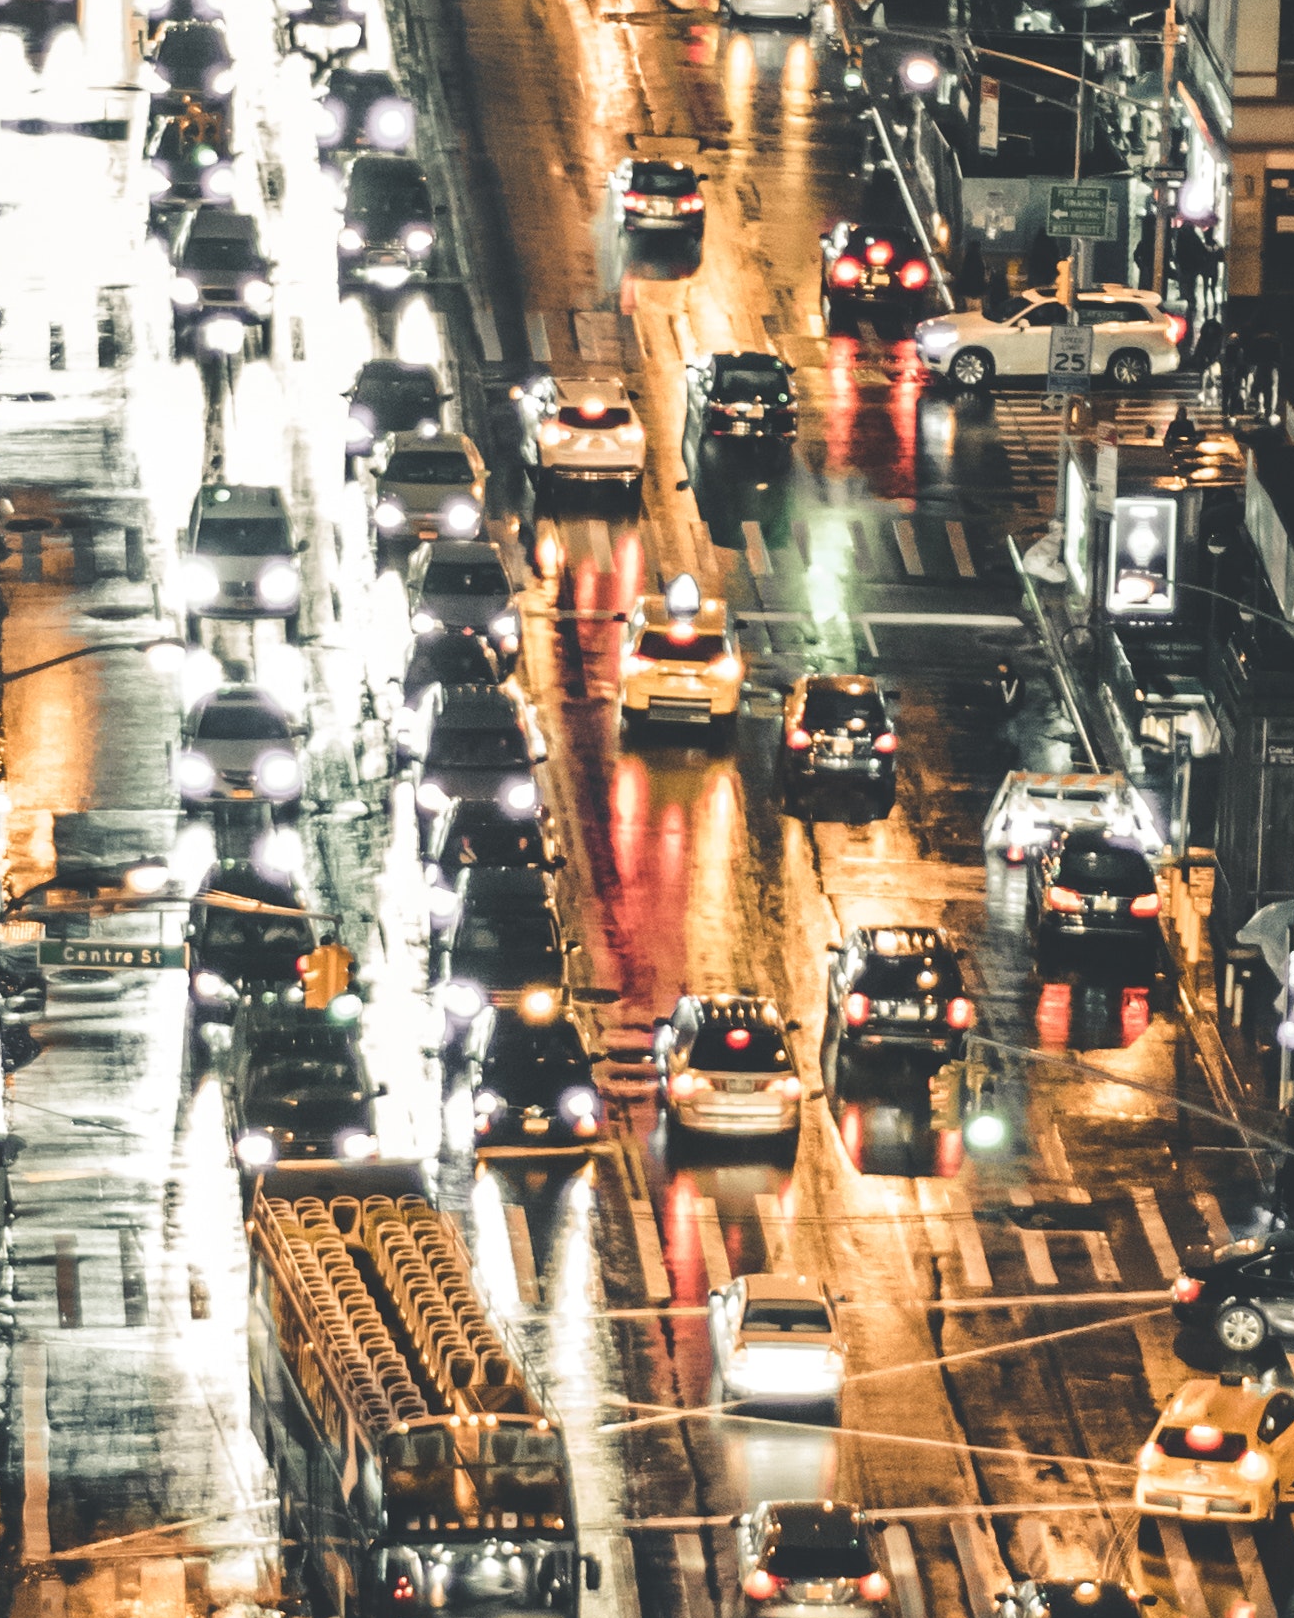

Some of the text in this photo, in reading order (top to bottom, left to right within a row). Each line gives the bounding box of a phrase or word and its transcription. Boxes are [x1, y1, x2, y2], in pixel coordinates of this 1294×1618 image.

[1054, 352, 1086, 372] 25
[63, 946, 162, 965] Centre St
